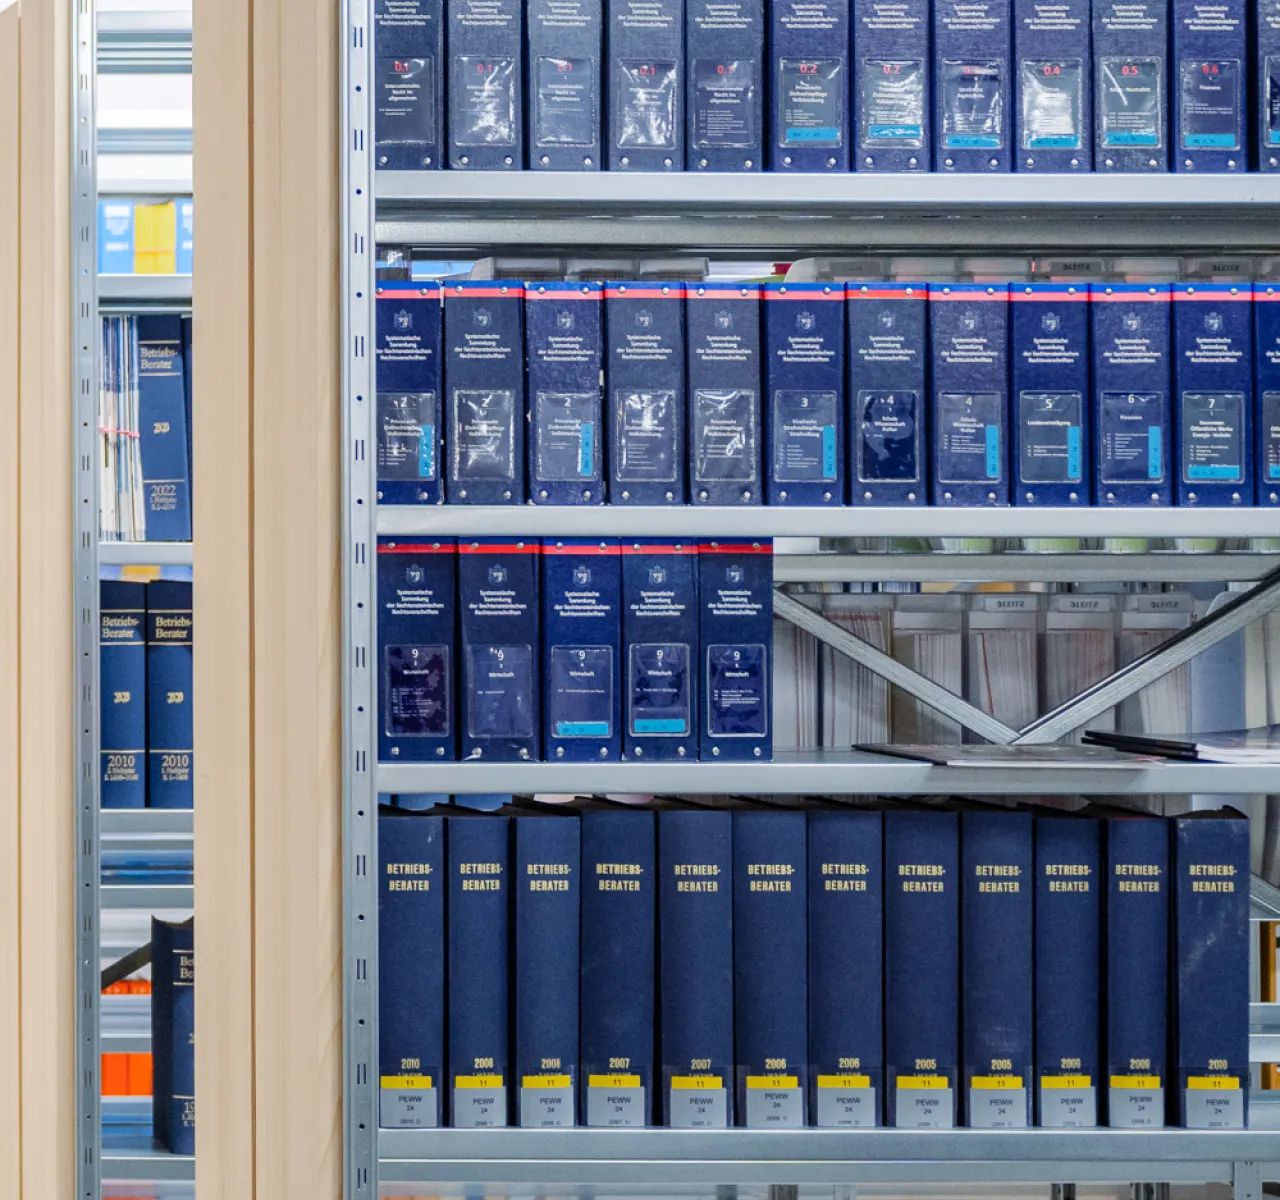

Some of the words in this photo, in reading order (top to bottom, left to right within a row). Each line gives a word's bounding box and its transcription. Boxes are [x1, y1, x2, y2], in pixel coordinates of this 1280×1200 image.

[800, 64, 817, 74] 0.2
[883, 64, 900, 74] 0.2
[1043, 66, 1060, 75] 0.4
[1122, 65, 1138, 76] 0.5
[401, 397, 407, 407] 2
[564, 398, 571, 407] 2
[801, 398, 808, 407] 3
[887, 396, 894, 404] 4
[965, 397, 972, 405] 4
[1045, 399, 1052, 408] 5
[1128, 395, 1134, 403] 6
[1208, 399, 1215, 408] 7
[151, 485, 175, 496] 2022
[103, 616, 139, 626] Betriebs-
[156, 616, 192, 626] Betriebs-
[103, 628, 134, 637] Berater
[156, 628, 187, 637] Berater
[412, 649, 418, 658] 9
[498, 651, 503, 660] 9
[579, 651, 585, 659] 9
[656, 650, 663, 659] 9
[733, 651, 740, 660] 9
[109, 755, 135, 766] 2010
[162, 755, 188, 766] 2010
[387, 864, 433, 874] BETRIEBS-
[460, 863, 503, 874] BETRIEBS-
[527, 864, 571, 874] BETRIEBS-
[596, 864, 644, 874] BETRIEBS-
[675, 865, 721, 875] BETRIEBS-
[748, 865, 795, 875] BETRIEBS-
[822, 864, 869, 874] BETRIEBS-
[899, 865, 946, 875] BETRIEBS-
[976, 865, 1021, 876] BETRIEBS-
[1046, 865, 1091, 875] BETRIEBS-
[1116, 865, 1161, 875] BETRIEBS-
[1190, 865, 1237, 875] BETRIEBS-
[389, 880, 429, 891] BERATER
[463, 880, 500, 890] BERATER
[530, 880, 568, 891] BERATER
[599, 880, 640, 891] BERATER
[678, 881, 718, 892] BERATER
[750, 881, 791, 891] BERATER
[825, 880, 866, 891] BERATER
[903, 881, 943, 892] BERATER
[979, 882, 1019, 892] BERATER
[1049, 881, 1089, 892] BERATER
[1119, 881, 1159, 892] BERATER
[1193, 881, 1234, 892] BERATER
[401, 1058, 420, 1069] 2010
[474, 1058, 493, 1068] 2008
[541, 1058, 561, 1069] 2008
[609, 1058, 630, 1068] 2007
[691, 1059, 711, 1069] 2007
[765, 1058, 786, 1069] 2006
[839, 1058, 860, 1068] 2006
[915, 1059, 936, 1069] 2005
[991, 1059, 1012, 1070] 2005
[1061, 1058, 1081, 1069] 2009
[1130, 1059, 1150, 1069] 2009
[1208, 1059, 1228, 1070] 2010
